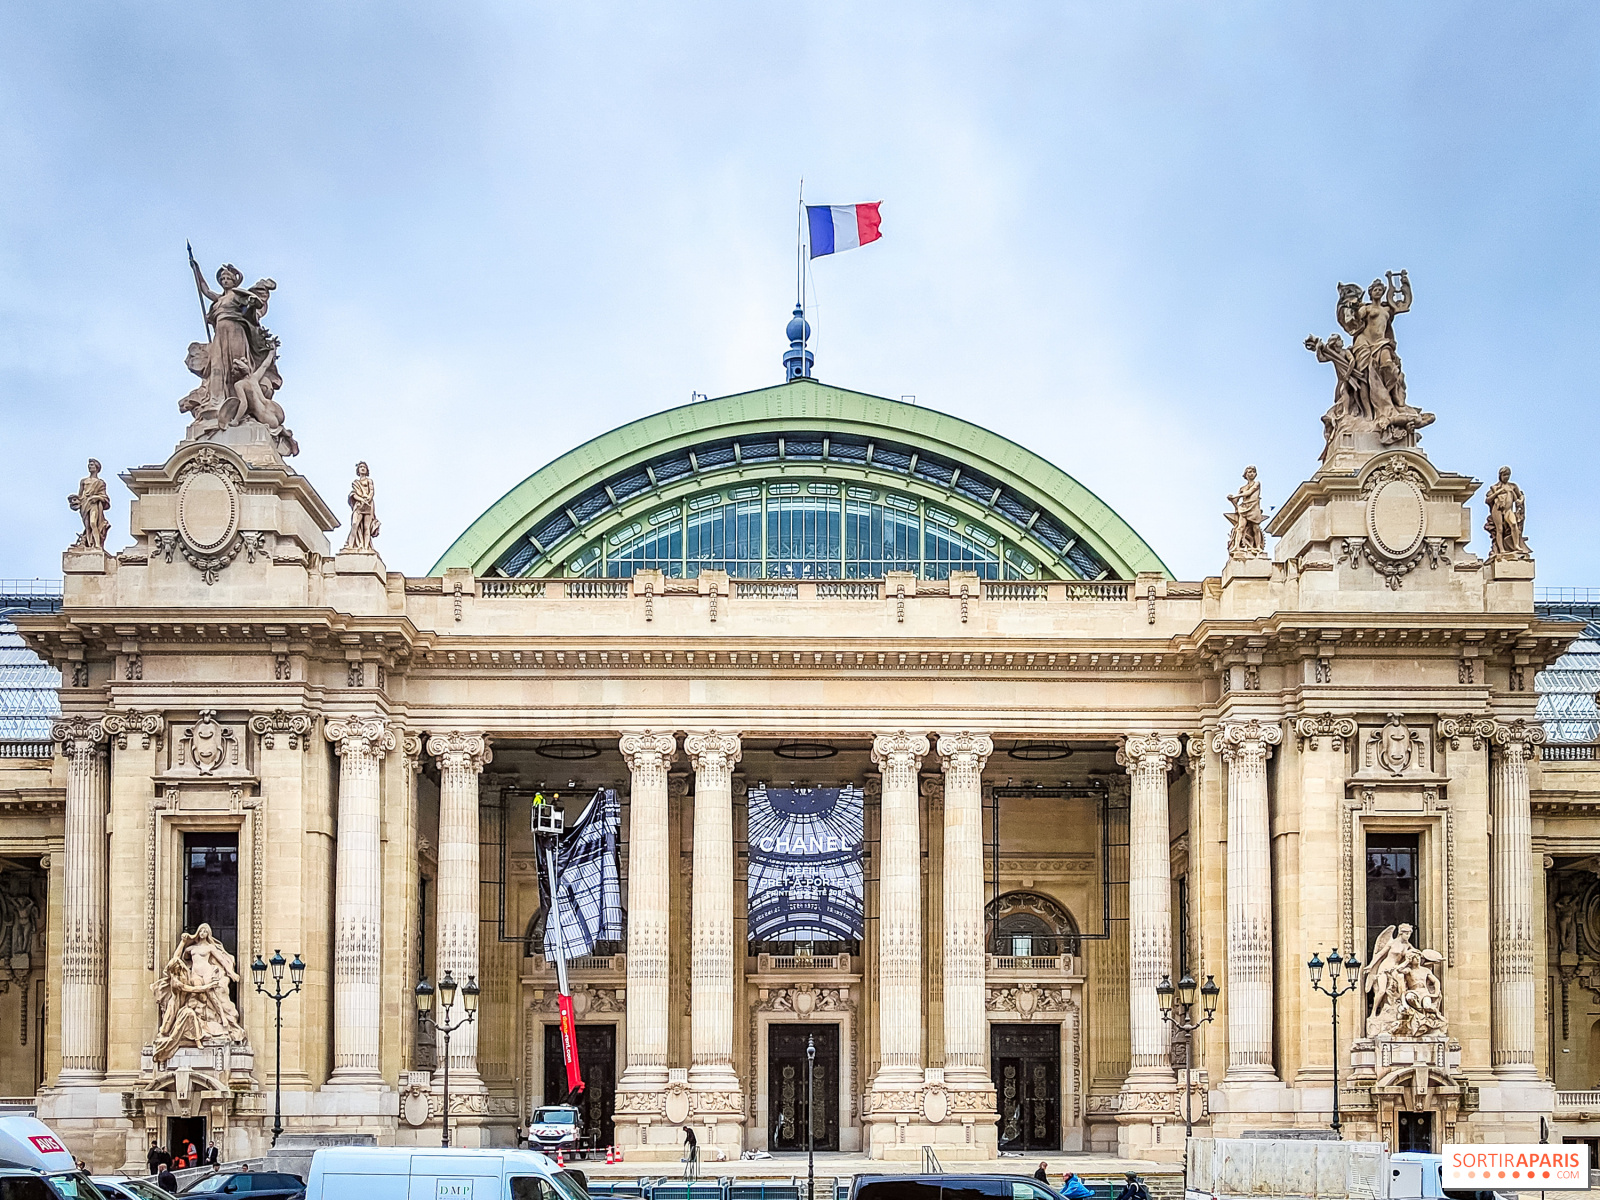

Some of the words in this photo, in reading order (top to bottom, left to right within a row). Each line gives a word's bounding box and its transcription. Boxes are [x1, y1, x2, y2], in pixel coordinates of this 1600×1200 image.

[760, 836, 852, 852] CHANEL
[35, 1137, 60, 1151] AVIS
[440, 1186, 470, 1195] DMP
